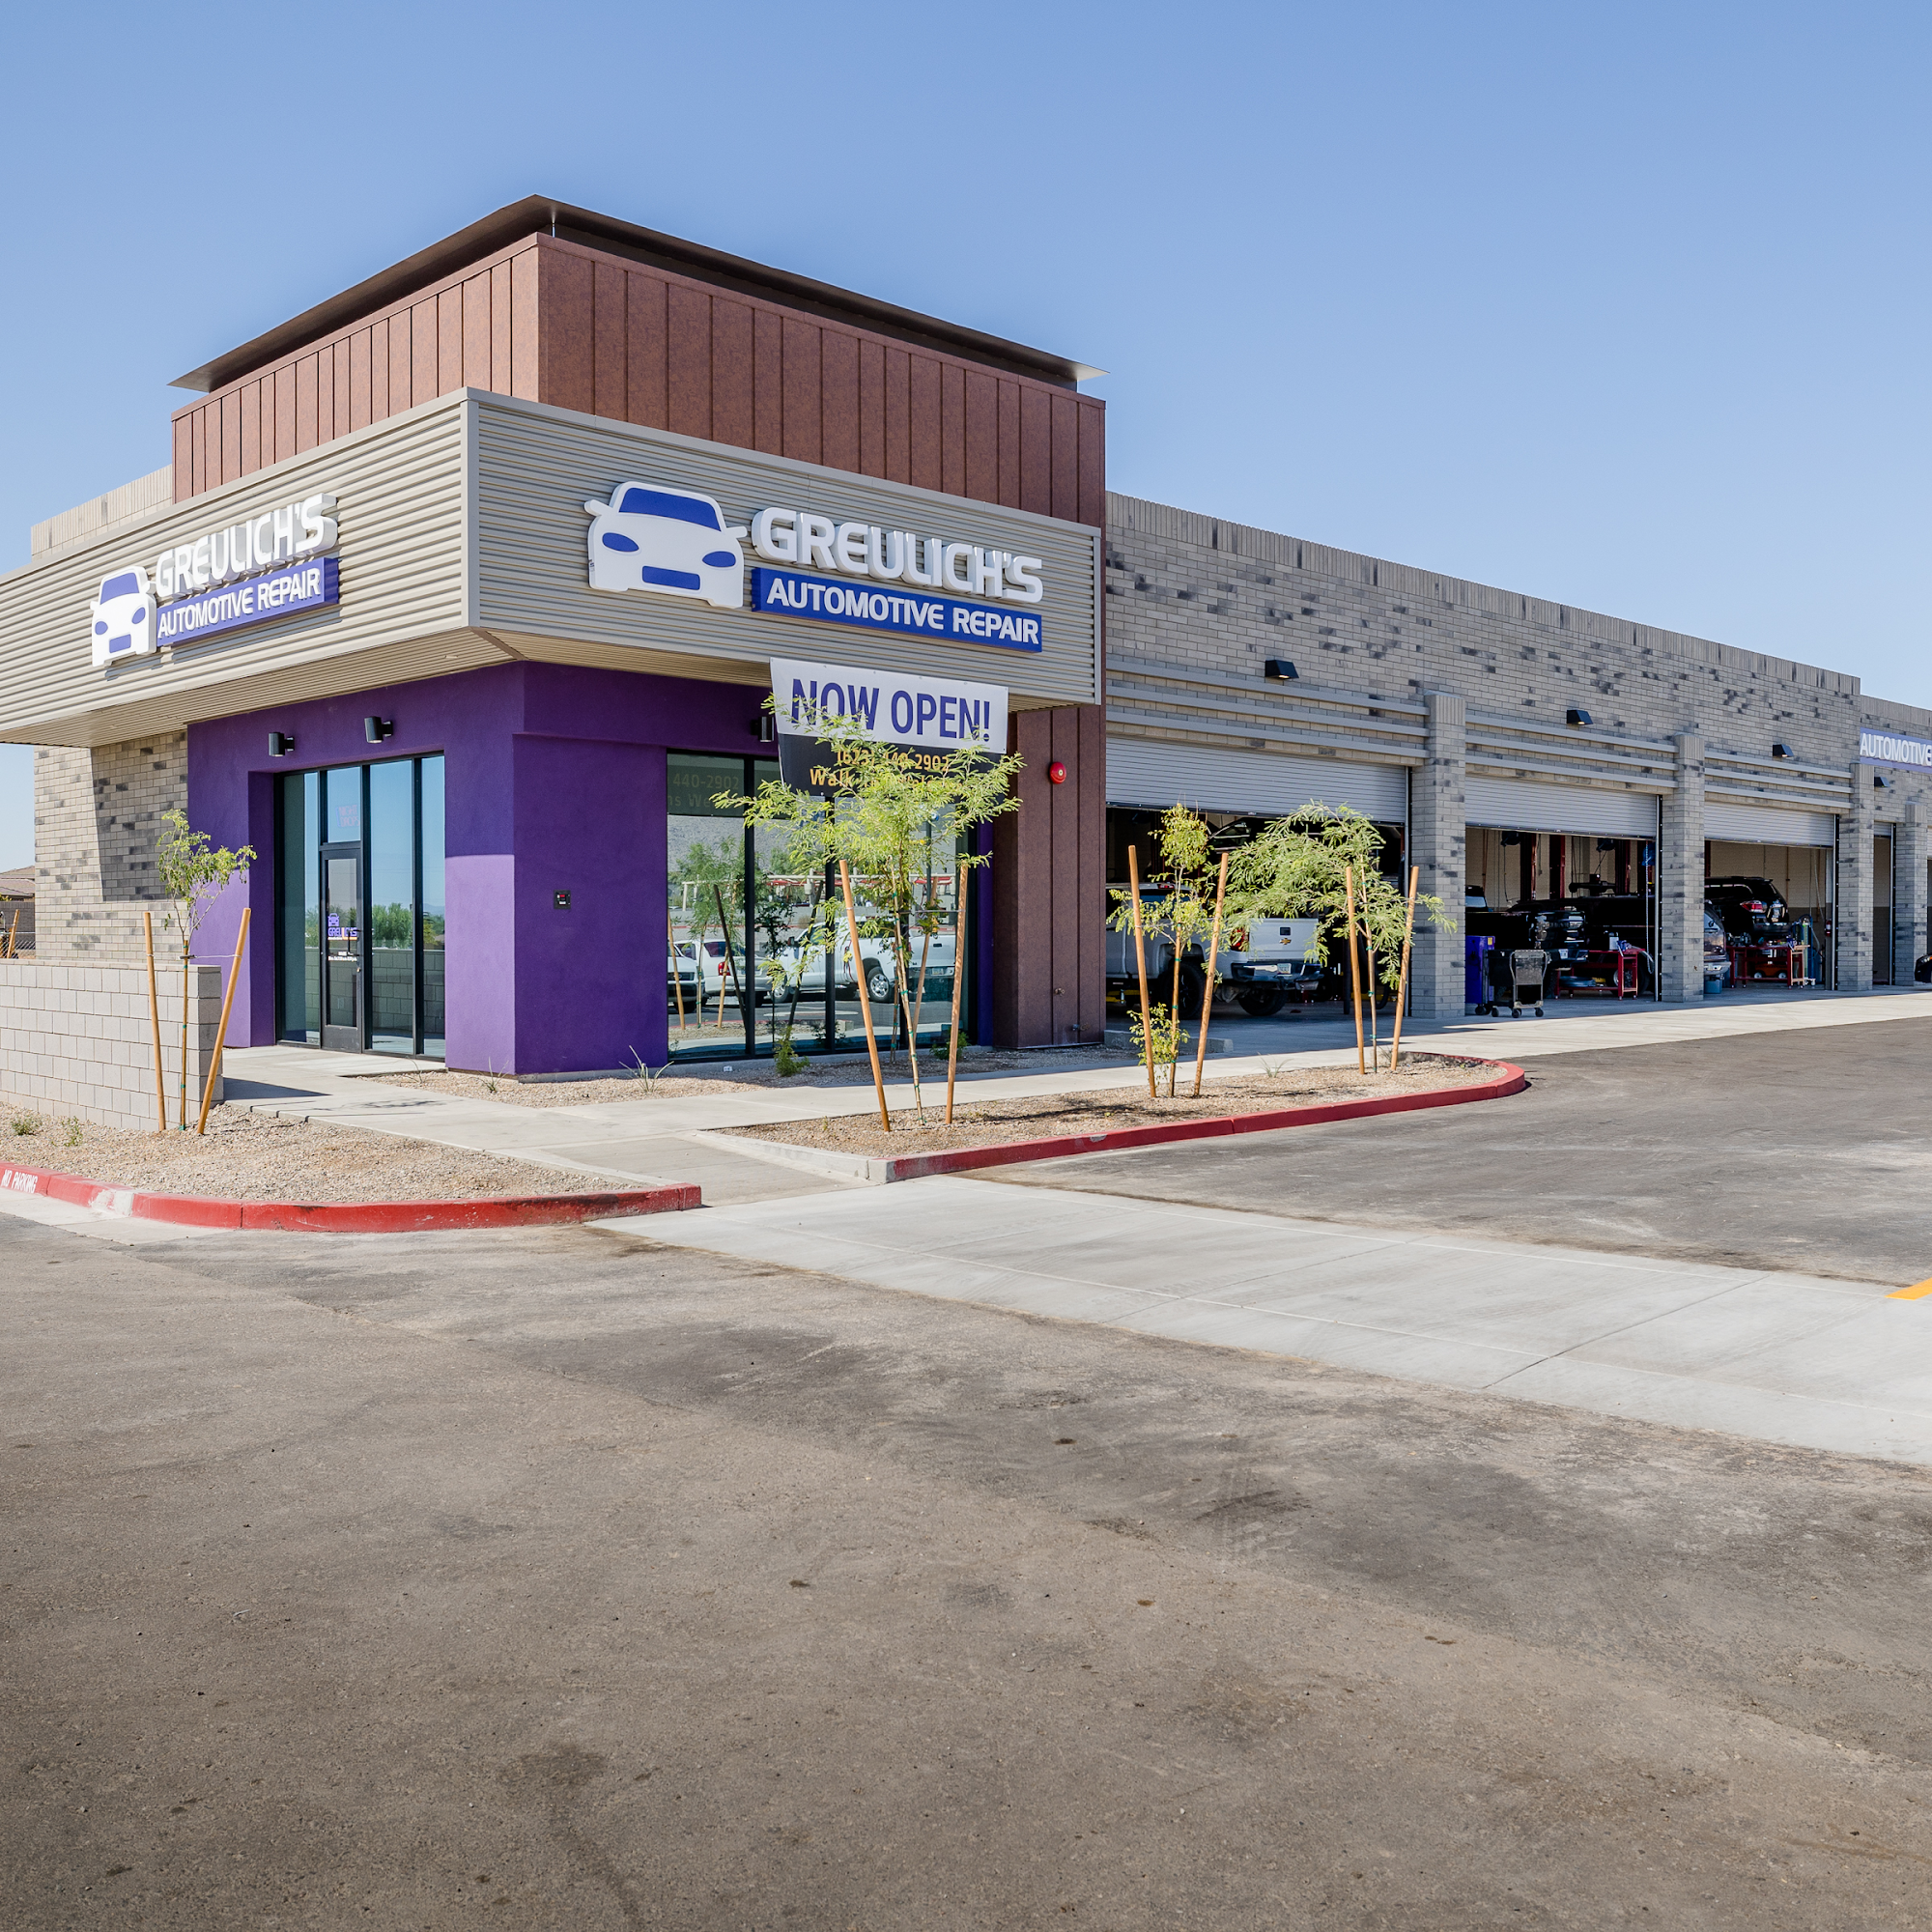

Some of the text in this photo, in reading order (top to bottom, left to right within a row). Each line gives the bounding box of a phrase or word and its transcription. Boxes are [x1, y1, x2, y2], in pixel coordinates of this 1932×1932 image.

[156, 493, 336, 598] GREULICH'S
[752, 507, 1043, 604] GREULICH'S
[157, 567, 322, 639] AUTOMOTIVE REPAIR
[766, 578, 1039, 644] AUTOMOTIVE REPAIR
[791, 678, 990, 742] NOW OPEN!
[672, 773, 739, 790] 440-2902
[1860, 732, 1932, 767] AUTOMOTIVE
[1, 1169, 38, 1194] NO PARKING
